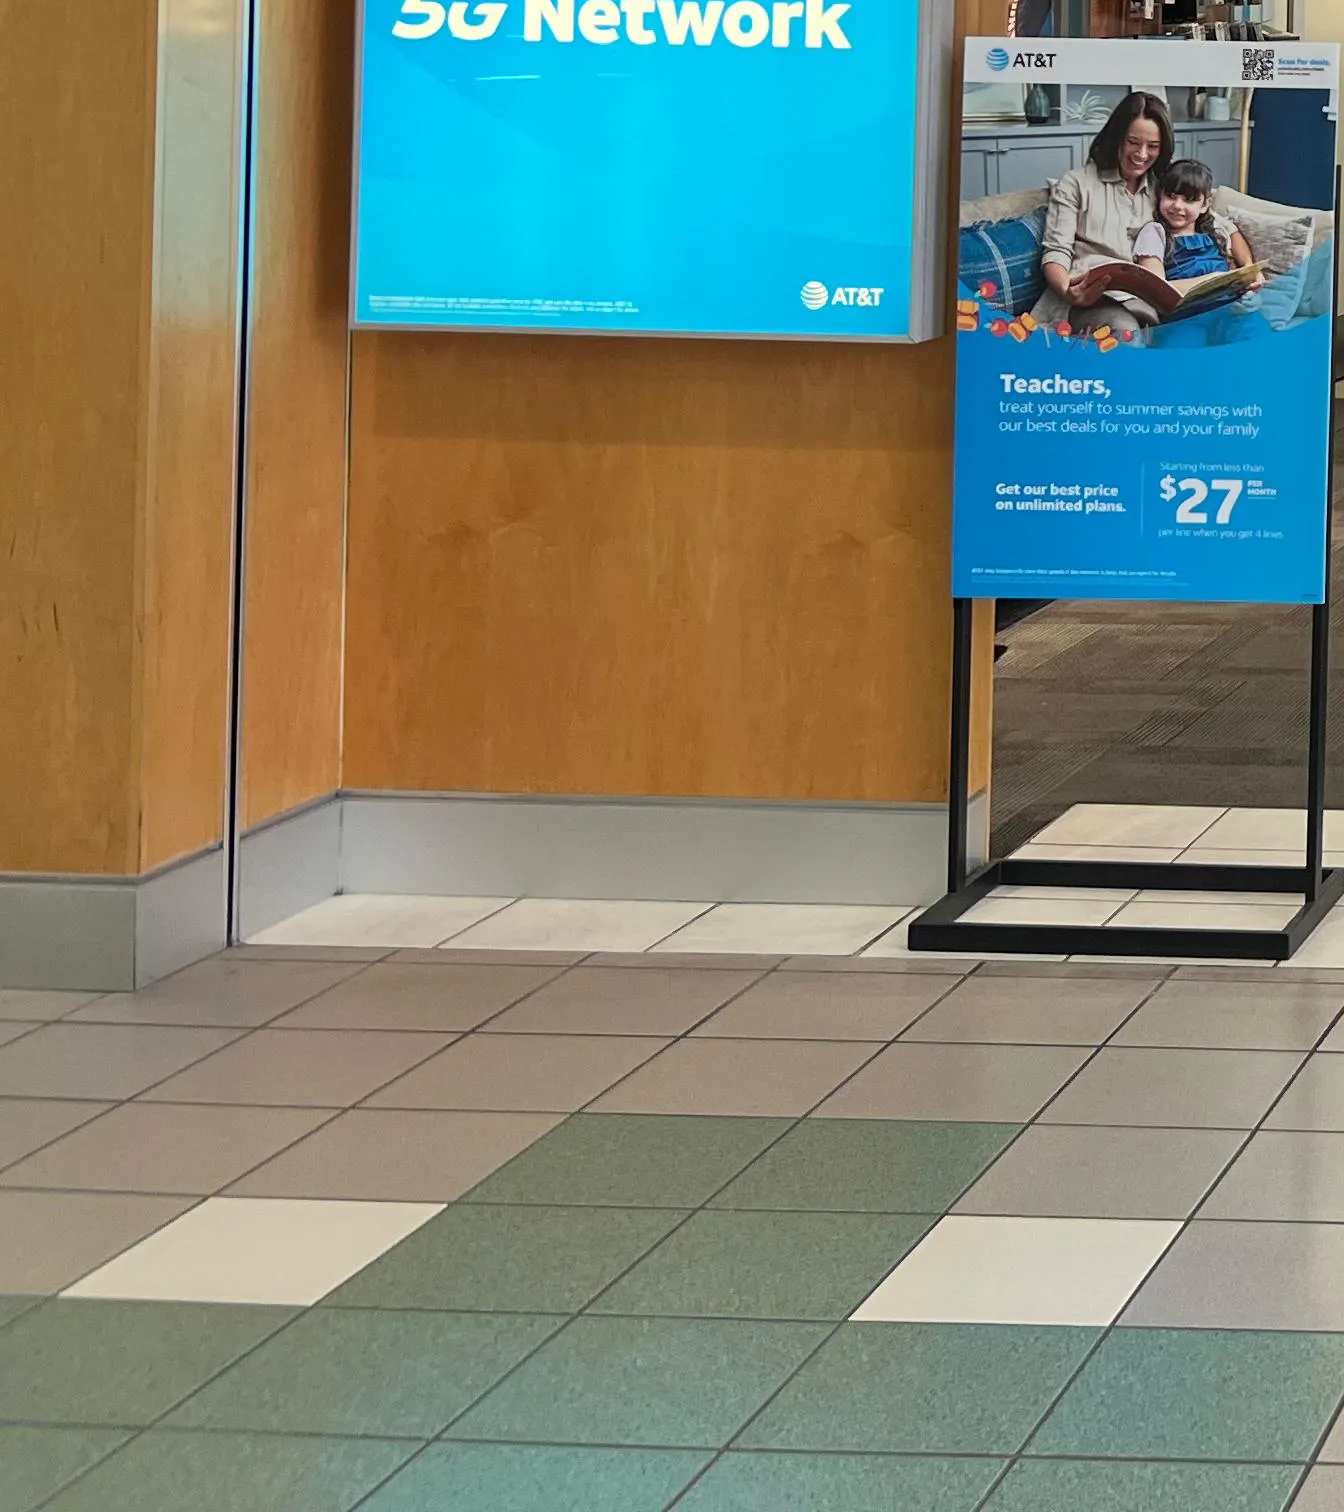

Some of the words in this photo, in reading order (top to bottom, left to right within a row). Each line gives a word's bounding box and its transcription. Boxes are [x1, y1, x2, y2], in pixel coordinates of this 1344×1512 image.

[1012, 52, 1057, 69] AT&T
[832, 288, 884, 308] AT&T
[999, 373, 1112, 398] Teachers,
[999, 400, 1033, 414] treat
[1037, 400, 1094, 417] yourself
[1097, 401, 1113, 415] to
[1115, 404, 1175, 416] summer
[1177, 403, 1229, 420] savings
[1232, 404, 1263, 418] with
[998, 421, 1022, 432] our
[1026, 419, 1058, 432] best
[1060, 419, 1097, 433] deals
[1100, 420, 1121, 433] for
[1123, 423, 1150, 437] you
[1153, 421, 1180, 434] and
[1182, 423, 1216, 438] your
[1159, 461, 1197, 473] Starting
[1199, 462, 1222, 473] from
[1223, 463, 1241, 472] less
[1242, 463, 1265, 473] than
[995, 483, 1021, 496] Get
[1023, 485, 1047, 496] our
[1050, 484, 1080, 497] best
[1083, 484, 1119, 500] price
[1159, 474, 1244, 524] $27
[1247, 488, 1277, 496] MONTH
[995, 500, 1013, 511] on
[1016, 498, 1083, 512] unlimited
[1085, 499, 1127, 514] plans.
